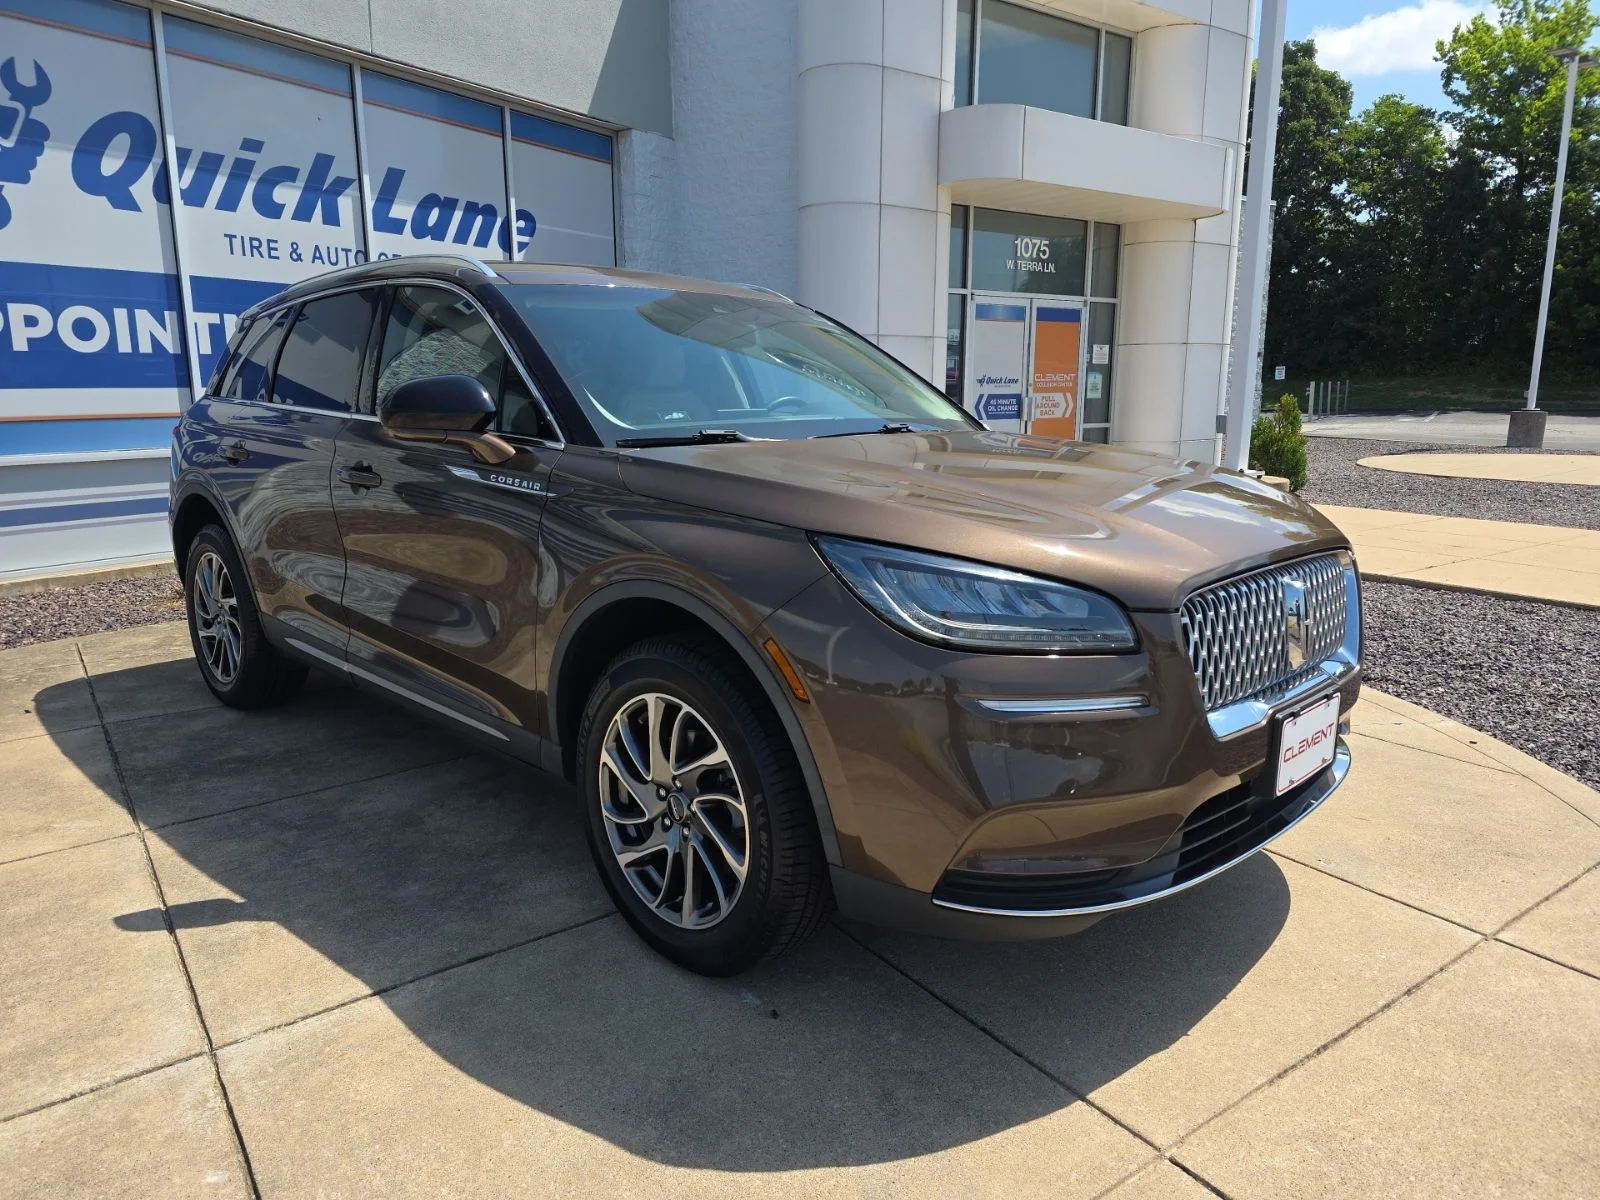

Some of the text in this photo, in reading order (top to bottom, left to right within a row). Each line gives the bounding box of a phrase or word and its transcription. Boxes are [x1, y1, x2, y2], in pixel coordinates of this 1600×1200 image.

[71, 111, 537, 253] Quick Lane
[223, 233, 280, 260] TIRE
[289, 241, 303, 263] &
[1014, 238, 1049, 259] 1075
[1006, 259, 1056, 273] W. TERRA LN.
[0, 302, 239, 355] POINT
[986, 376, 1019, 385] Quick Lane
[1034, 373, 1076, 382] CLEMENT
[490, 474, 541, 490] CORSAIR
[1283, 722, 1335, 763] CLEMENT
